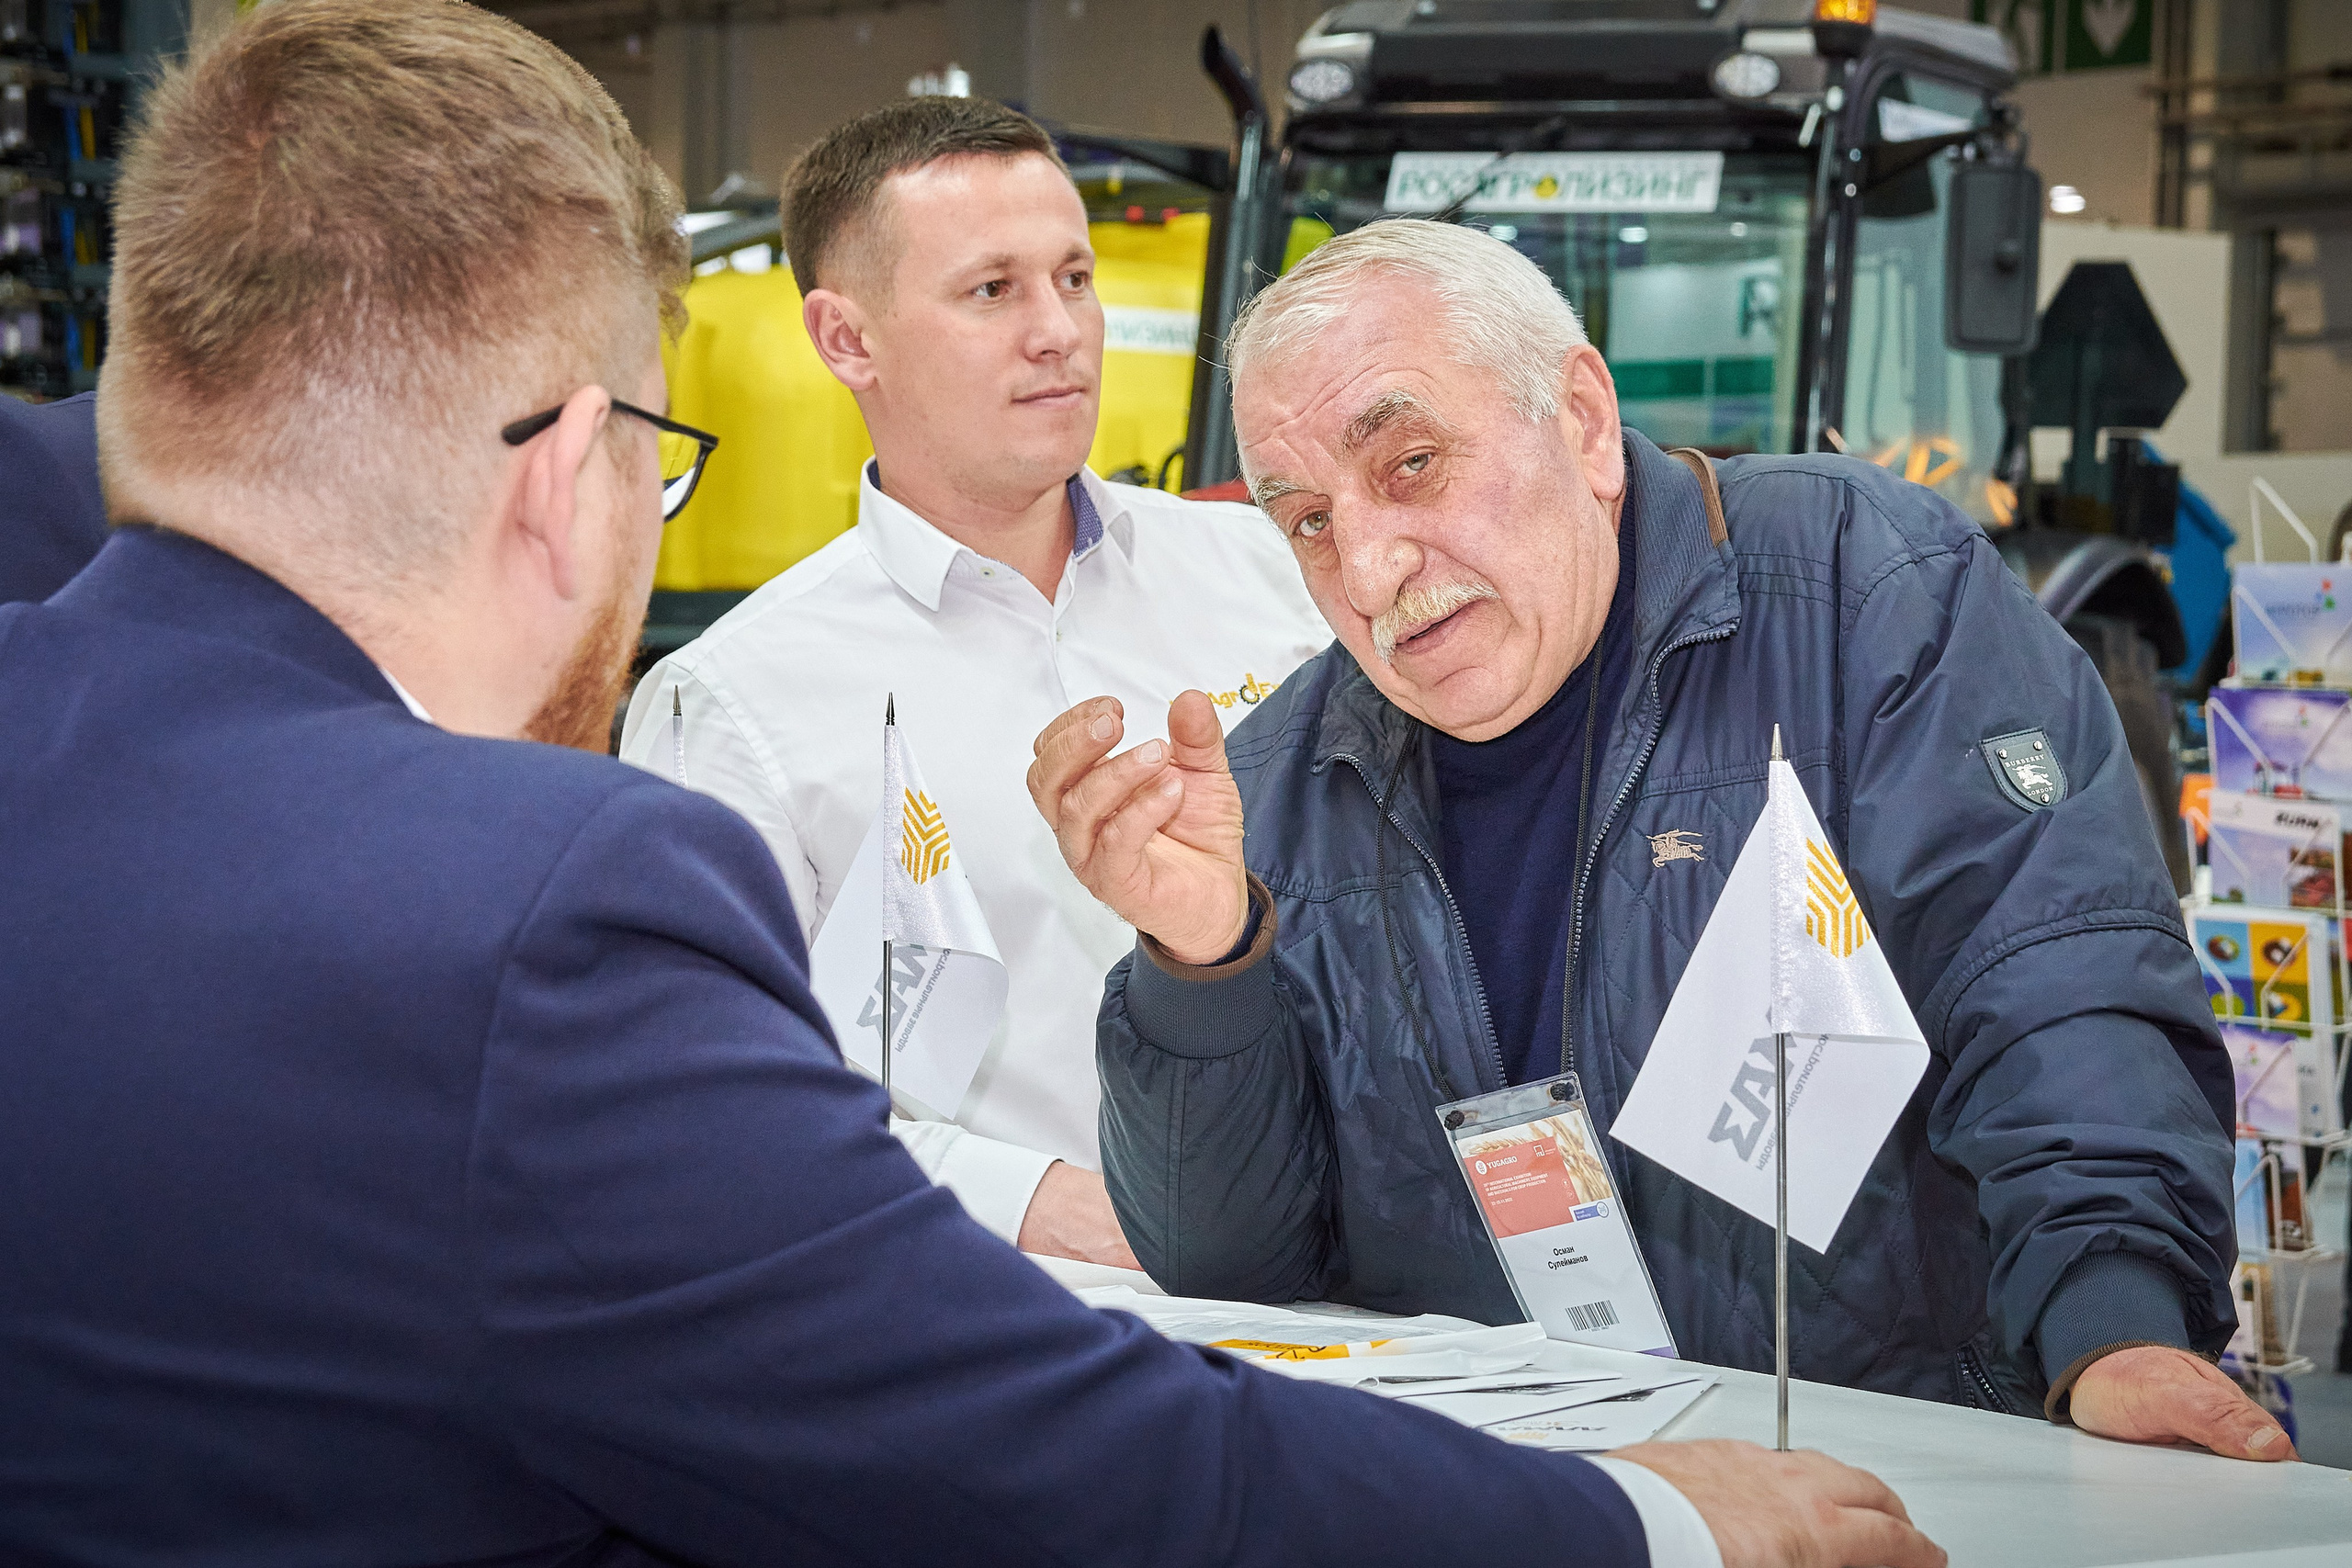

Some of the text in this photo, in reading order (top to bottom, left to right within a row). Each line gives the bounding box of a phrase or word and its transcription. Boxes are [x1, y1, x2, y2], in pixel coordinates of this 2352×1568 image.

[2004, 753, 2045, 768] BURBERRY
[2027, 785, 2054, 796] LONDON
[1487, 1156, 1518, 1169] YUGAGRO
[1553, 1246, 1575, 1257] Осман
[1547, 1255, 1589, 1270] Сулейманов
